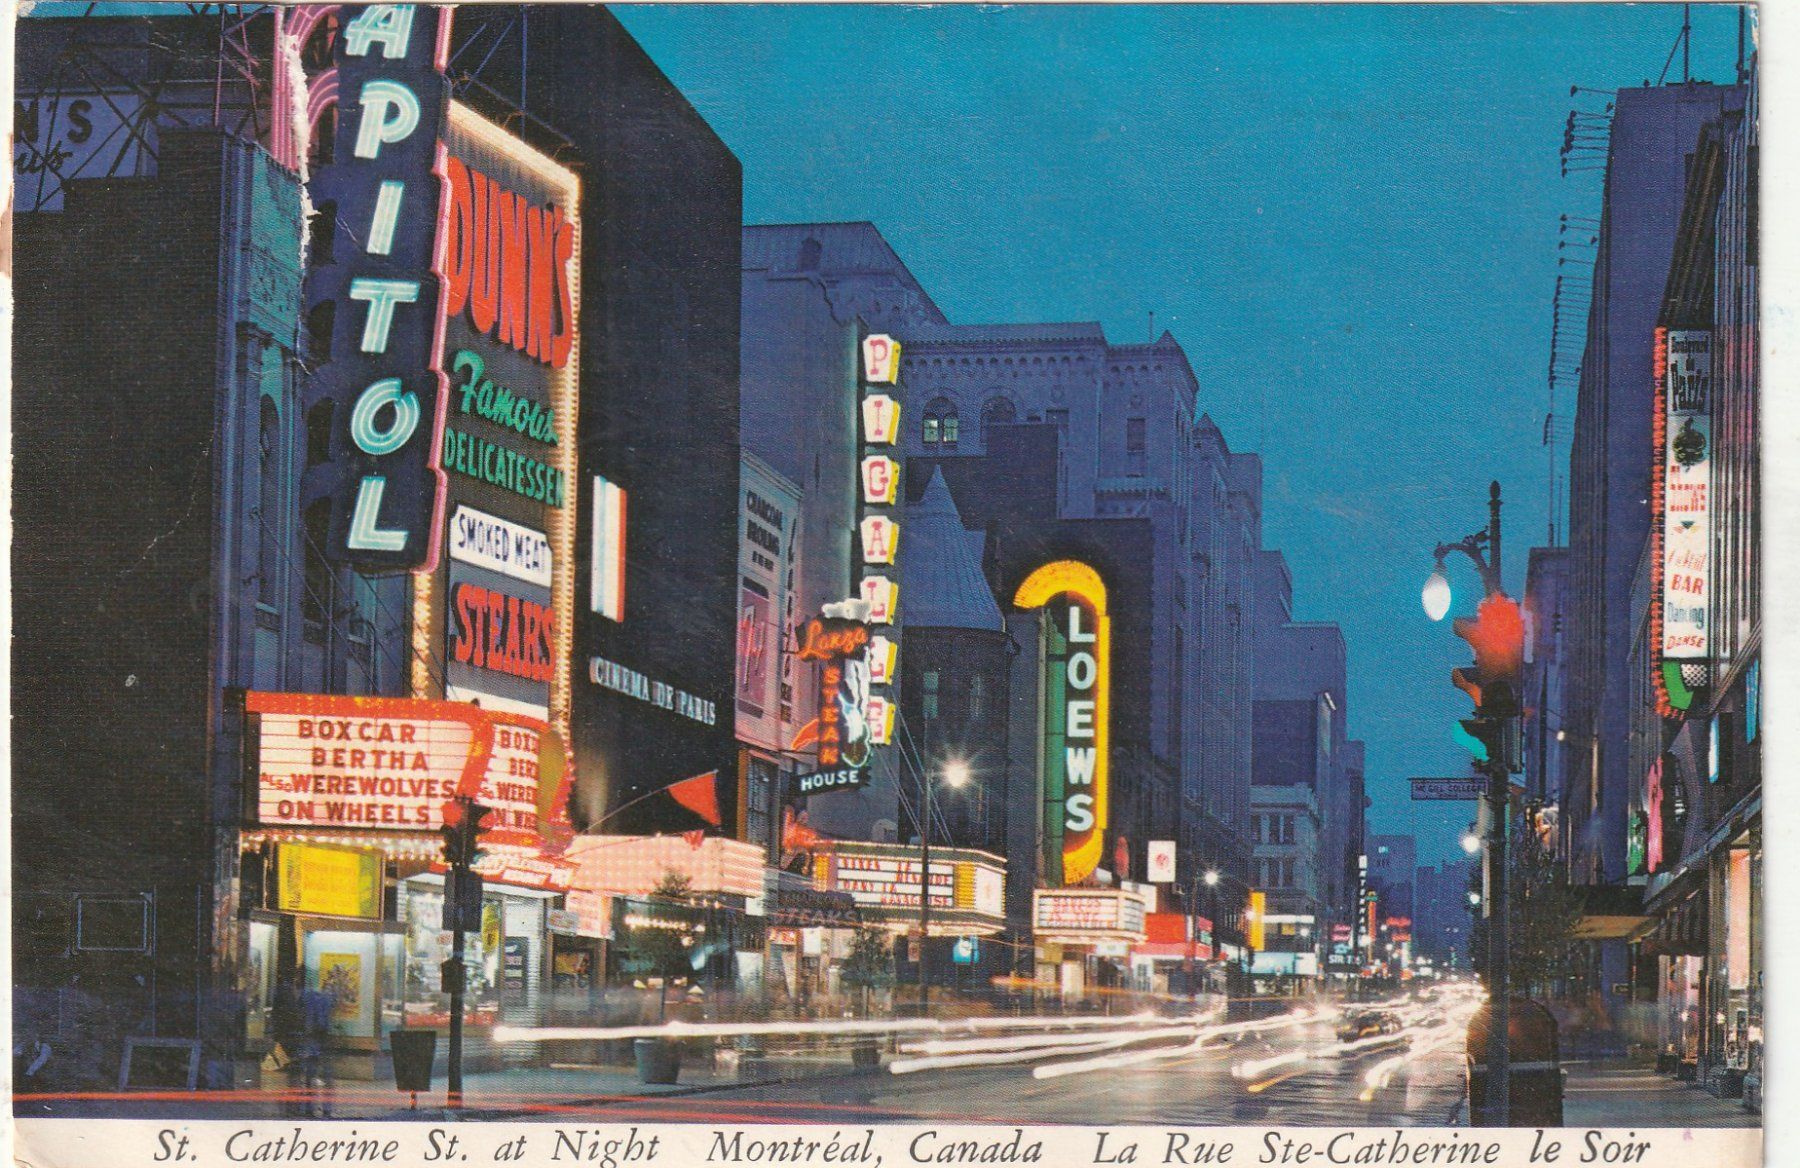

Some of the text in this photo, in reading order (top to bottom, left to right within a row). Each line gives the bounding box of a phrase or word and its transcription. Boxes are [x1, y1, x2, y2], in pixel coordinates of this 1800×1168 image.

[447, 156, 574, 369] DUNN'S
[453, 350, 560, 445] Famous
[458, 513, 547, 572] SMOKED MEAT
[1671, 574, 1704, 594] BAR
[591, 656, 716, 726] CINEMA DE PARIS
[298, 719, 416, 744] BOXCAR
[820, 666, 840, 766] STEAK
[1065, 606, 1097, 832] LOEWS
[311, 747, 429, 771] BERTHA
[291, 773, 456, 798] WEREWOLVES
[801, 770, 859, 792] HOUSE
[277, 800, 430, 824] ON WHEELS
